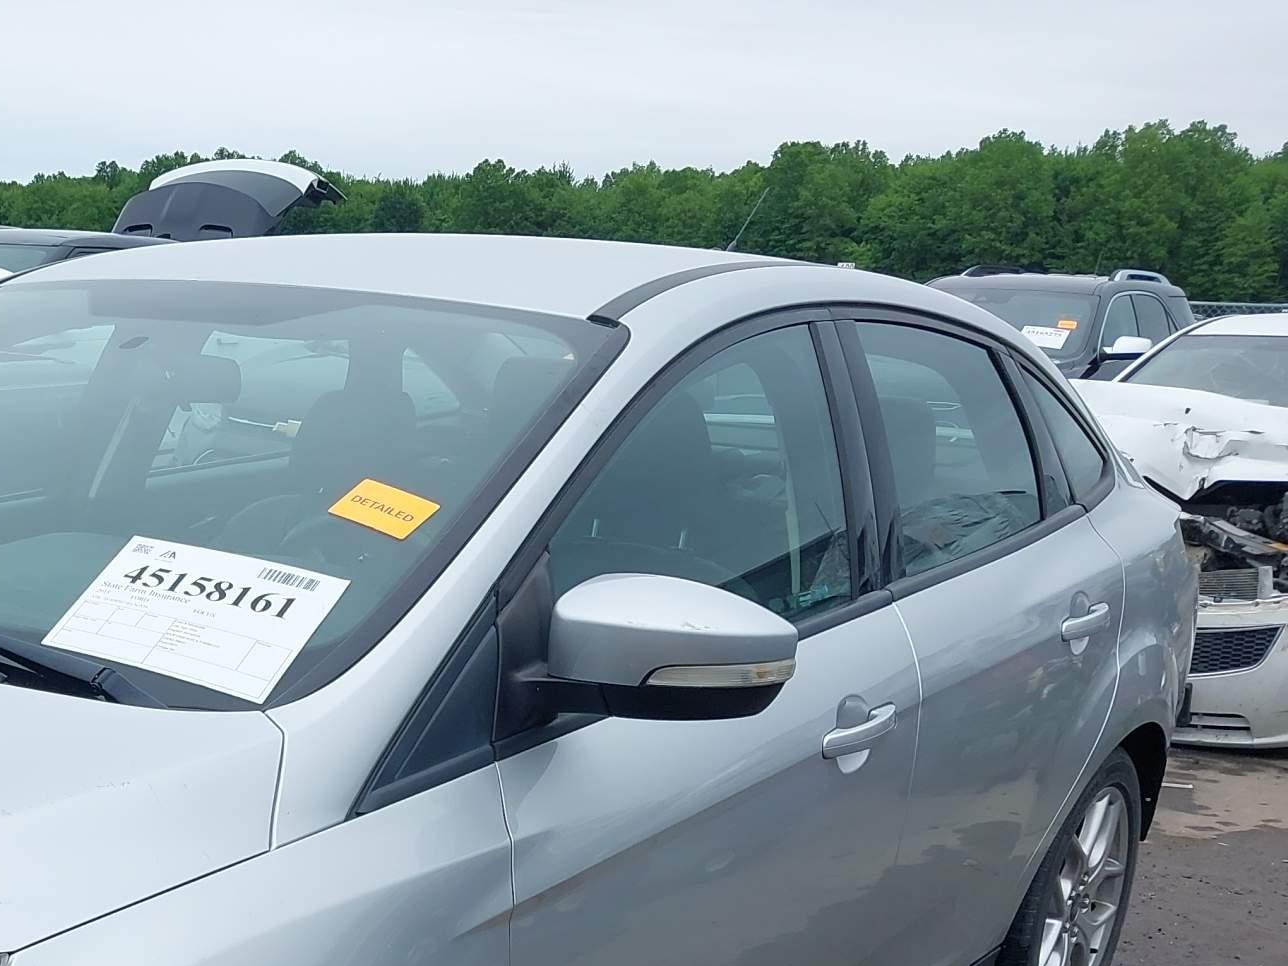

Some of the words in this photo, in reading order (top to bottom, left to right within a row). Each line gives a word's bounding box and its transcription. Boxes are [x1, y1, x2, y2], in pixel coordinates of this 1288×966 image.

[351, 495, 414, 521] DETAILED
[123, 565, 297, 620] 45158161
[148, 588, 192, 605] Insurance
